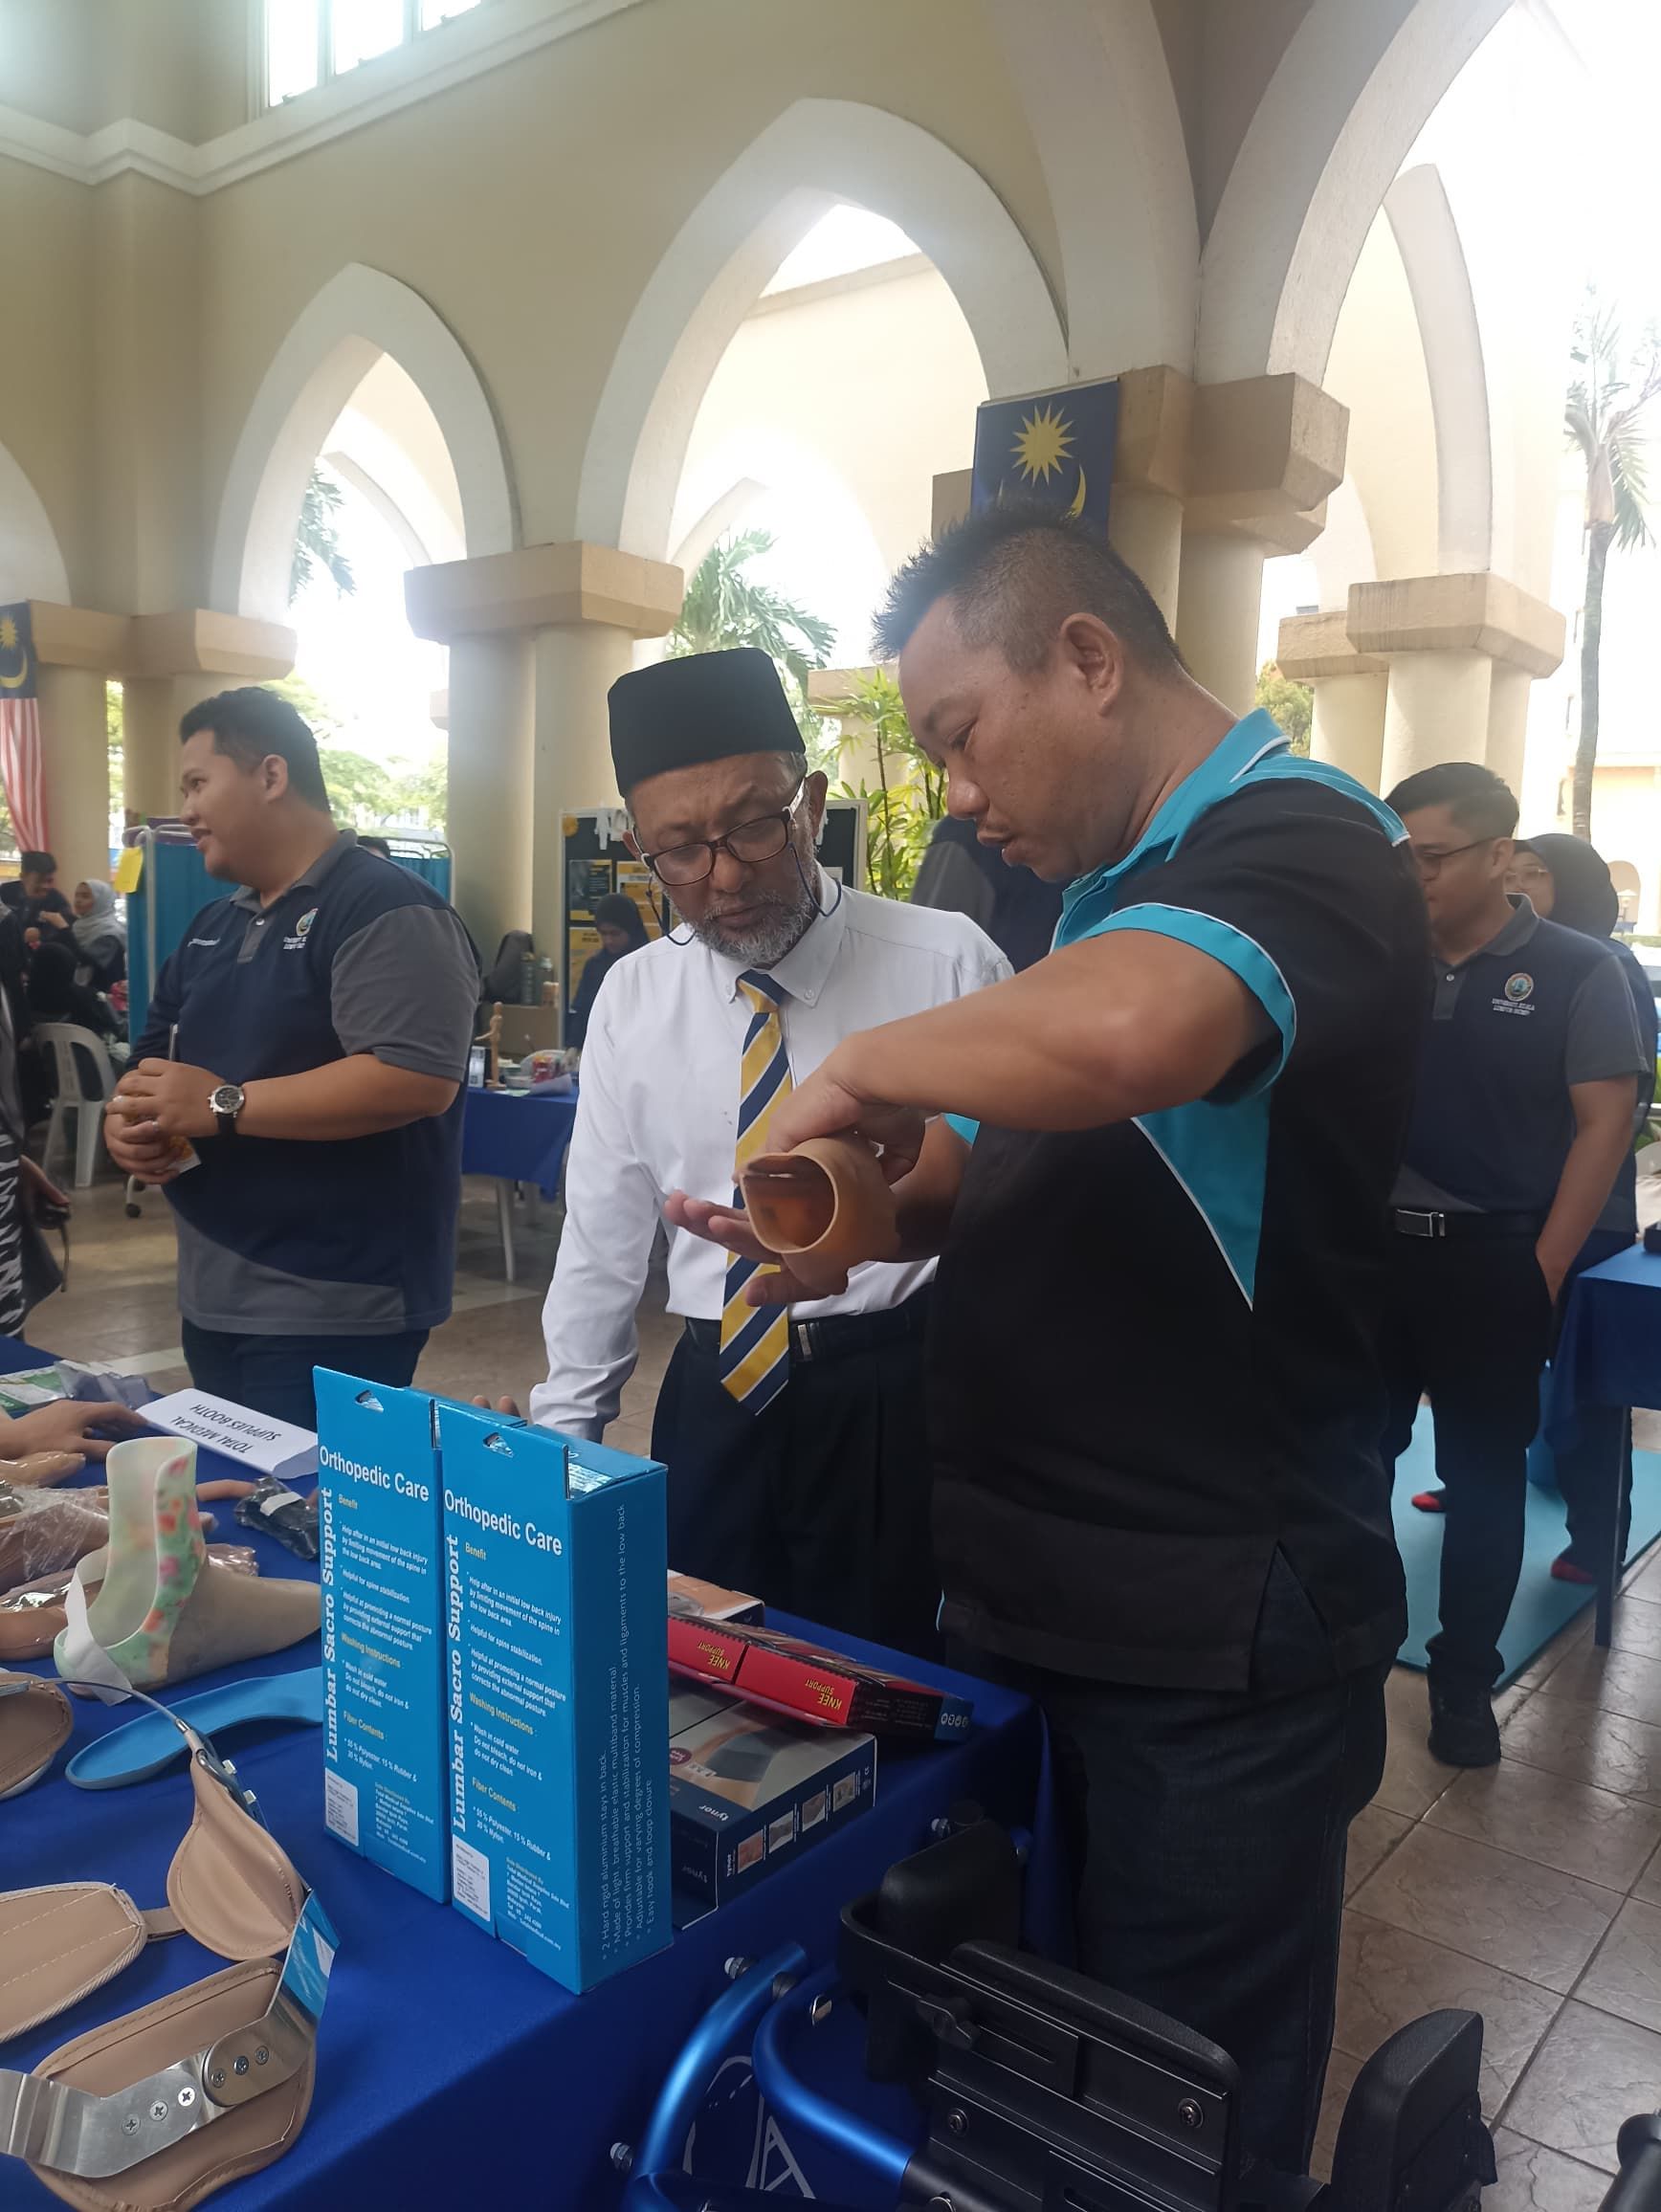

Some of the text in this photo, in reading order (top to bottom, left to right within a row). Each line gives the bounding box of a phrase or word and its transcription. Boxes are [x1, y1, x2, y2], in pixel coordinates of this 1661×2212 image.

[170, 1416, 253, 1453] TOTAL MEDICAL
[189, 1404, 281, 1441] SUPPLIES BOOTH
[320, 1445, 429, 1502] Orthopedic Care
[339, 1494, 358, 1510] Benefit
[444, 1489, 563, 1556] Orthopedic Care
[466, 1542, 486, 1560] Benefit
[321, 1487, 337, 1762] Lumbar Sacro Support
[342, 1632, 401, 1669] Washing Instructions
[698, 1640, 725, 1656] SUPPORT
[708, 1654, 731, 1670] KNEE
[447, 1535, 465, 1833] Lumbar Sacro Support
[805, 1678, 834, 1695] SUPPORT
[819, 1692, 842, 1710] KNEE
[343, 1711, 385, 1740] Fiber Contents
[470, 1692, 534, 1735] Washing Instructions
[473, 1777, 517, 1812] Fiber Contents
[698, 1804, 729, 1822] tynor
